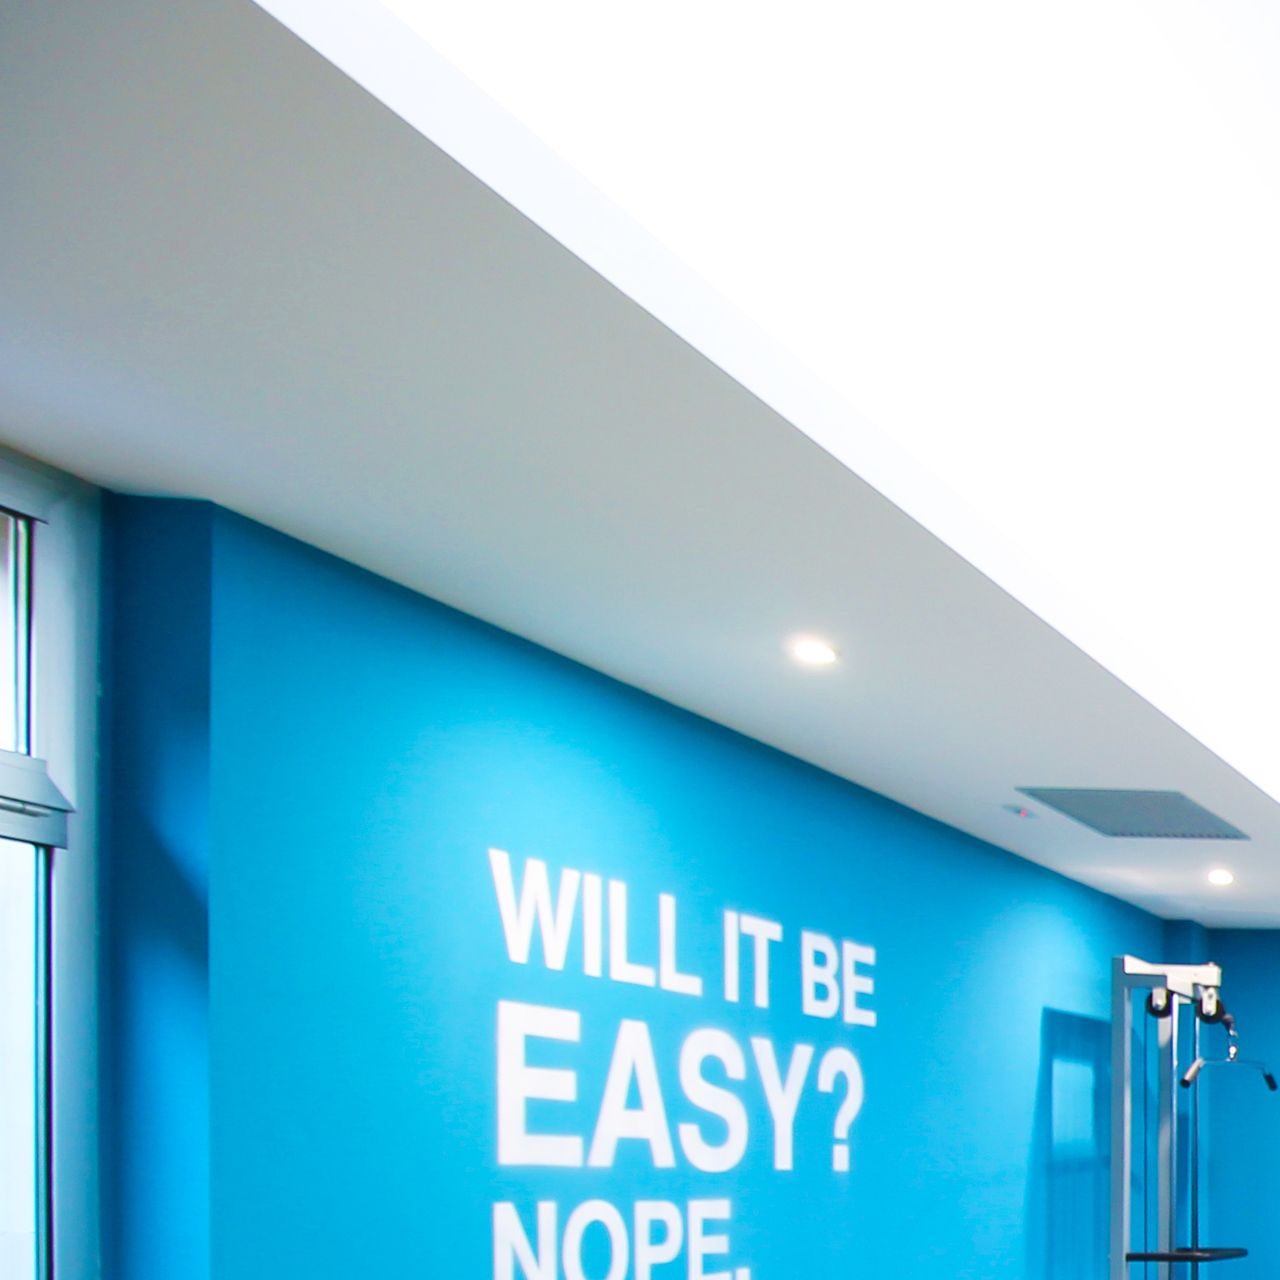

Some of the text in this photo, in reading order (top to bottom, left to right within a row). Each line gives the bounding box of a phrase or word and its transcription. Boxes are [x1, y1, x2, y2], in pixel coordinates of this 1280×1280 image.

[487, 847, 877, 1028] WILL IT BE
[495, 998, 865, 1174] EASY?
